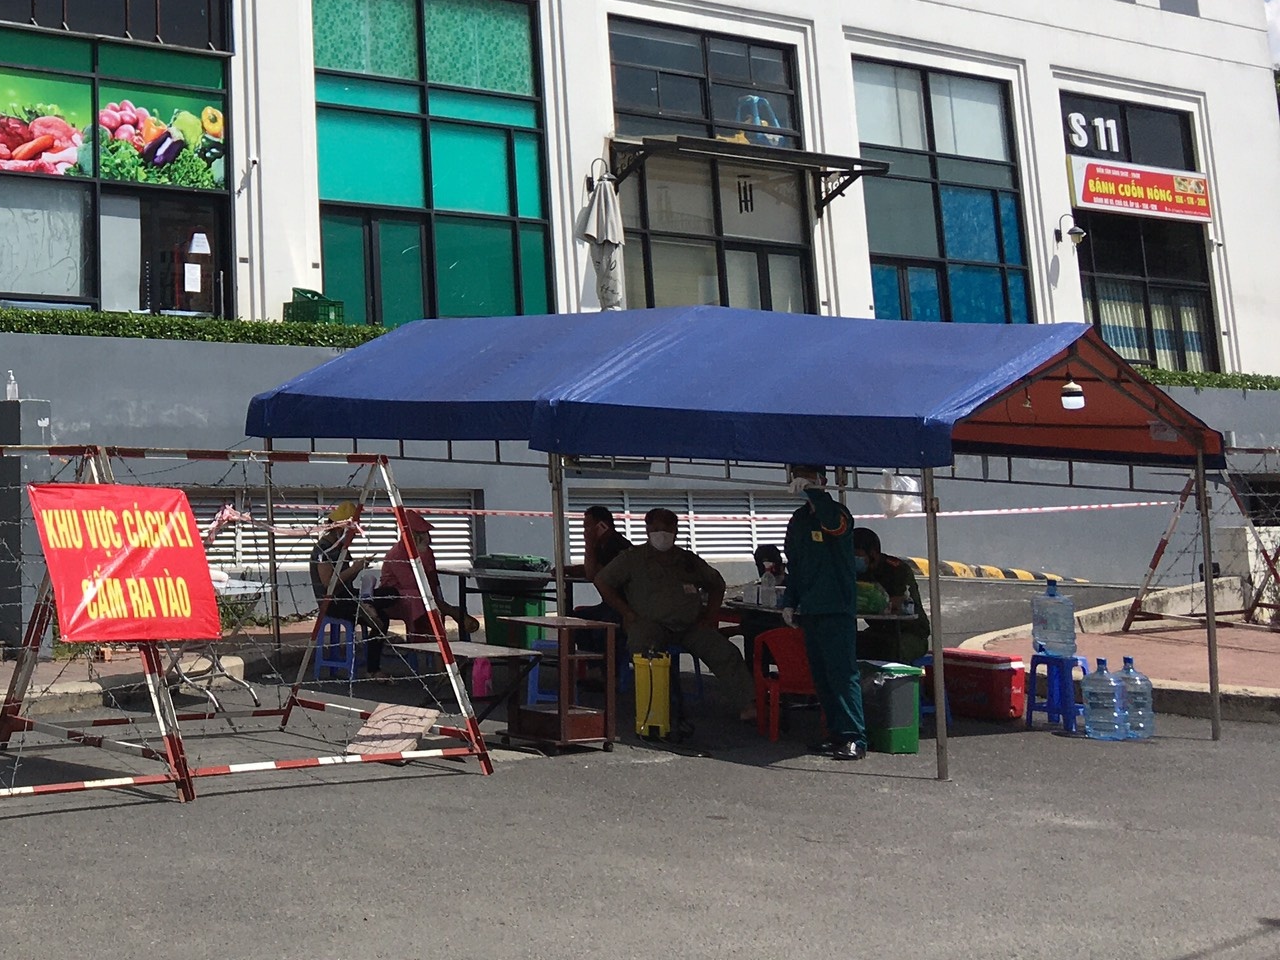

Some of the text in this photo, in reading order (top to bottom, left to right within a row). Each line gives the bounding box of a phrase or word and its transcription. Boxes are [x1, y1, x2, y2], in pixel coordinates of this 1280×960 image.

[1068, 112, 1120, 152] S 11
[1088, 177, 1116, 195] BÁNH
[1118, 179, 1144, 198] CUỐN
[41, 502, 194, 557] KHU VỰC CÁCH LY
[81, 564, 192, 620] CẤM RA VÀO
